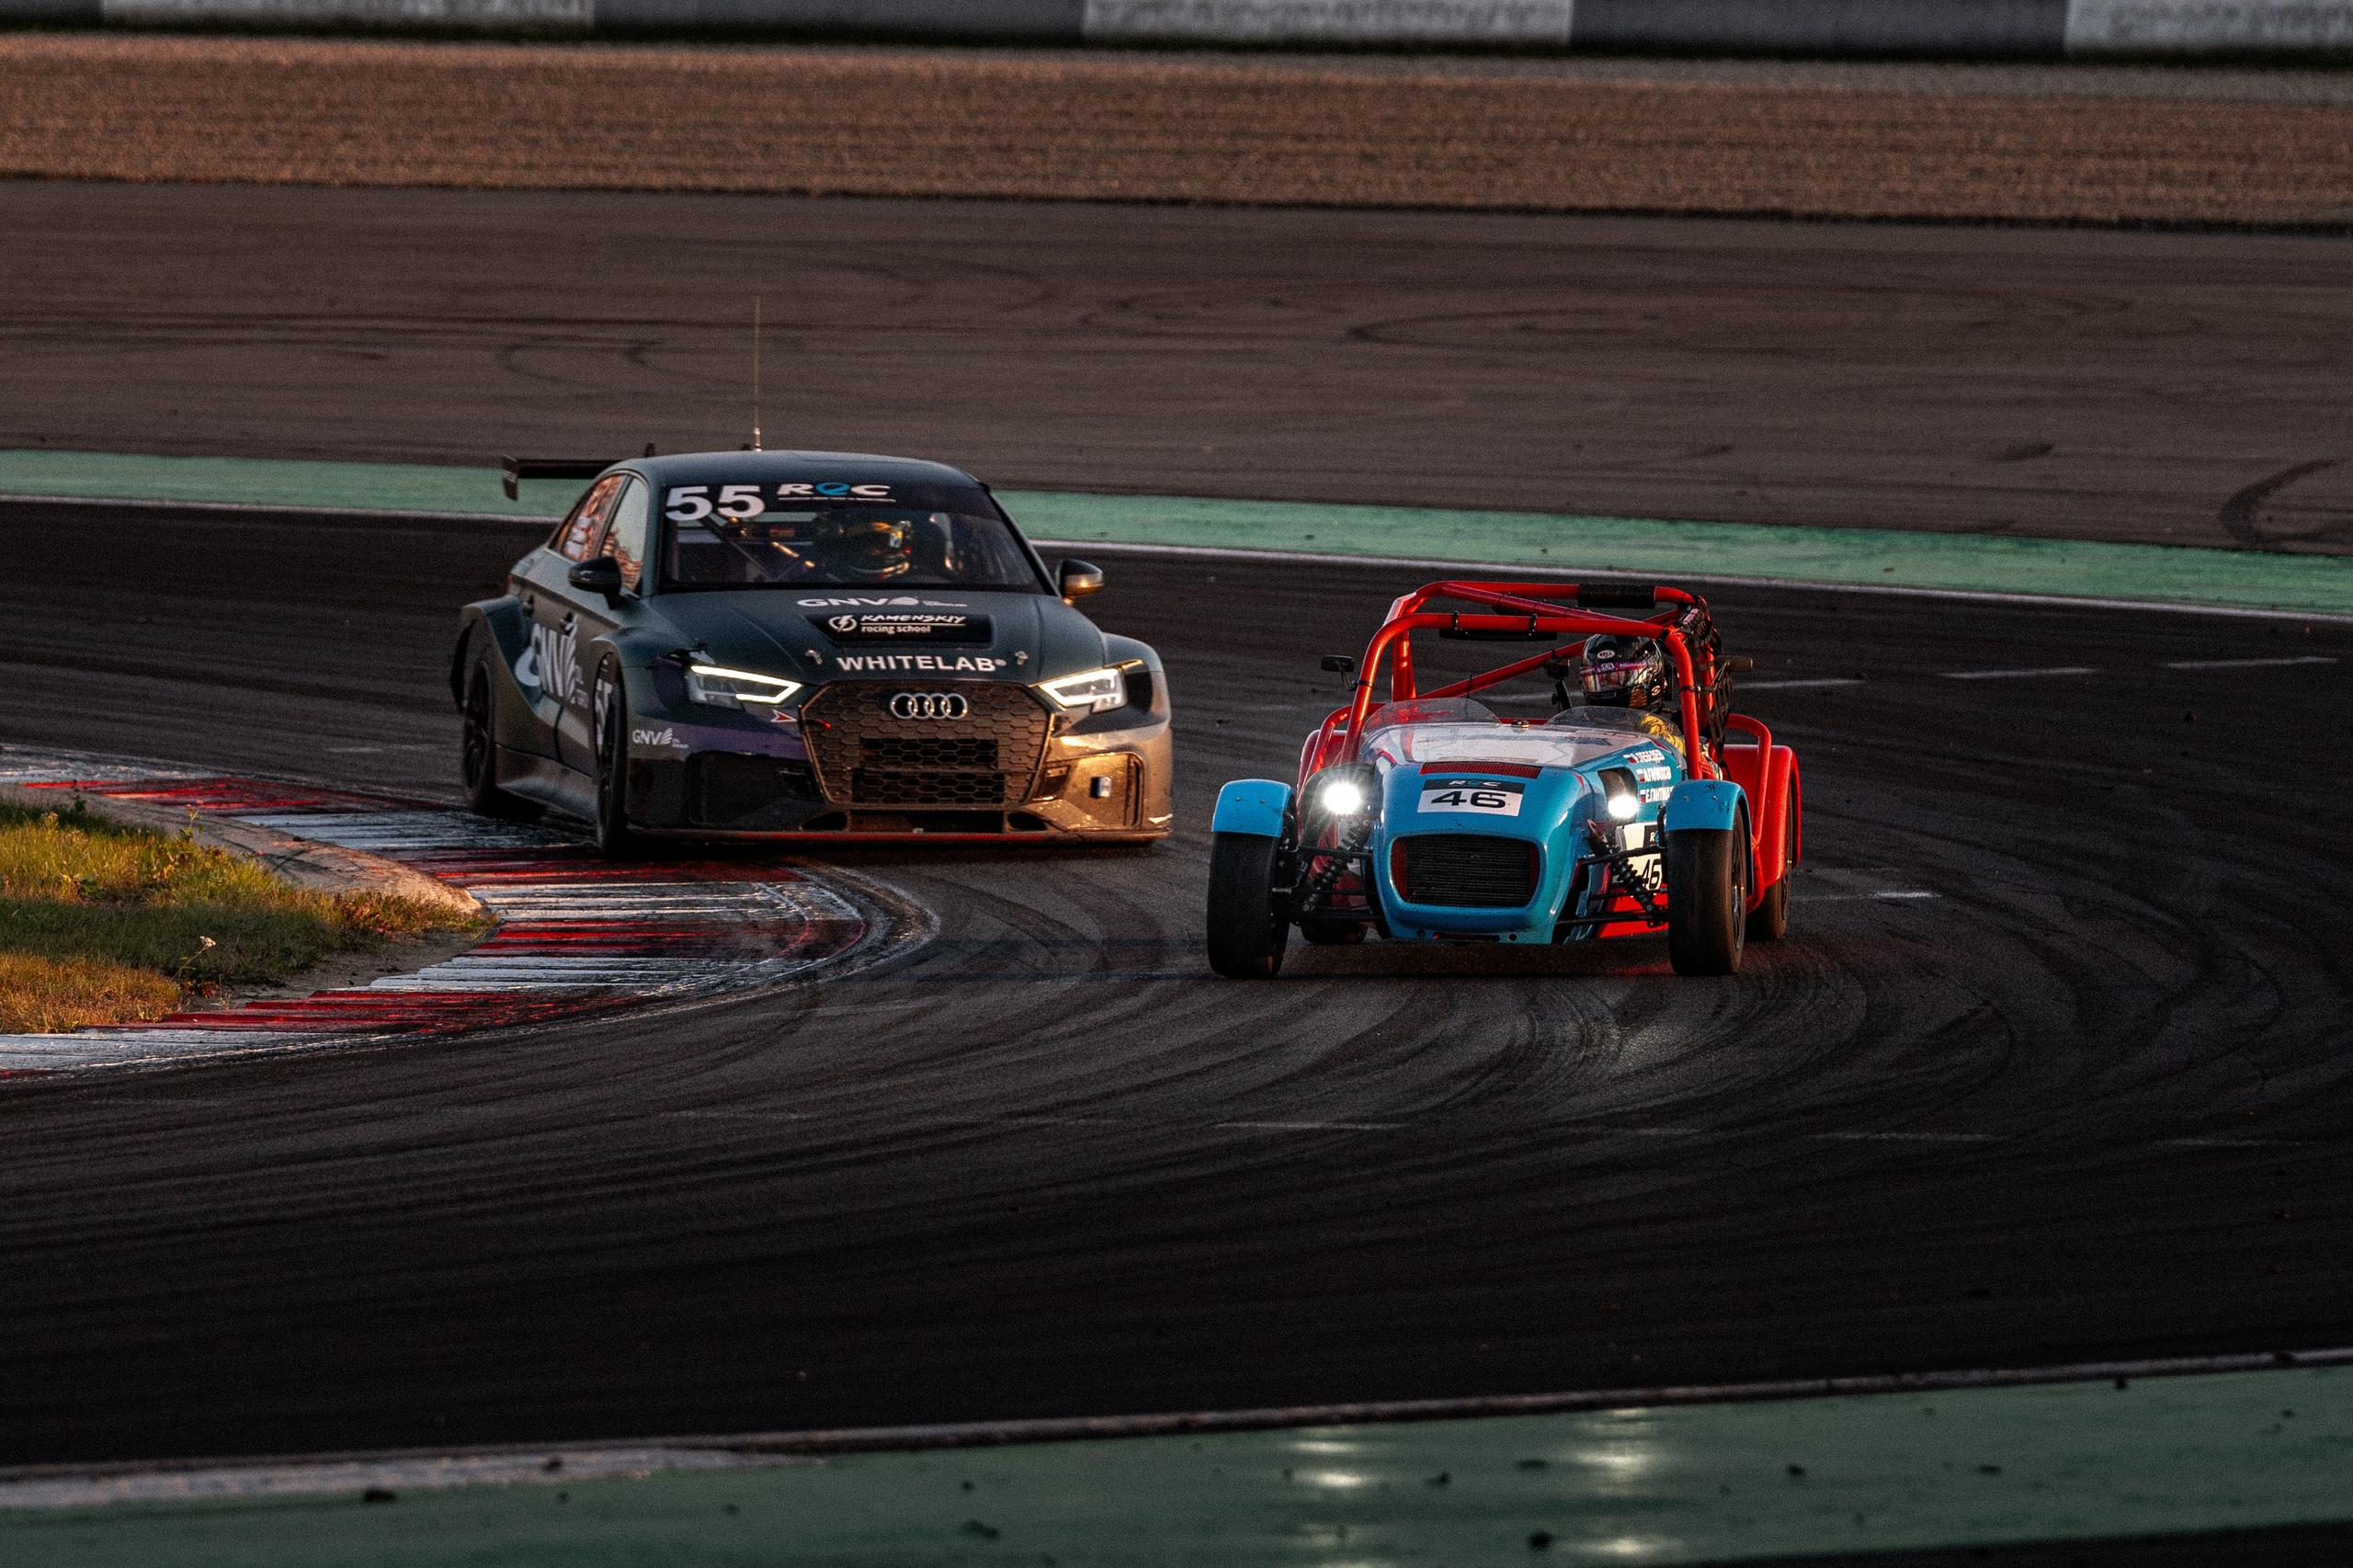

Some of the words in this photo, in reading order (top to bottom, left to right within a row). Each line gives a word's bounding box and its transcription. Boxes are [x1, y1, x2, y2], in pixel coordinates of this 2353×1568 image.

[665, 483, 766, 522] 55
[797, 597, 889, 608] GNV
[860, 614, 967, 624] KAMENSKIY
[861, 625, 894, 635] racing
[897, 624, 931, 633] school
[632, 729, 664, 745] GNV
[1430, 790, 1507, 810] 46
[1642, 858, 1662, 890] 46
